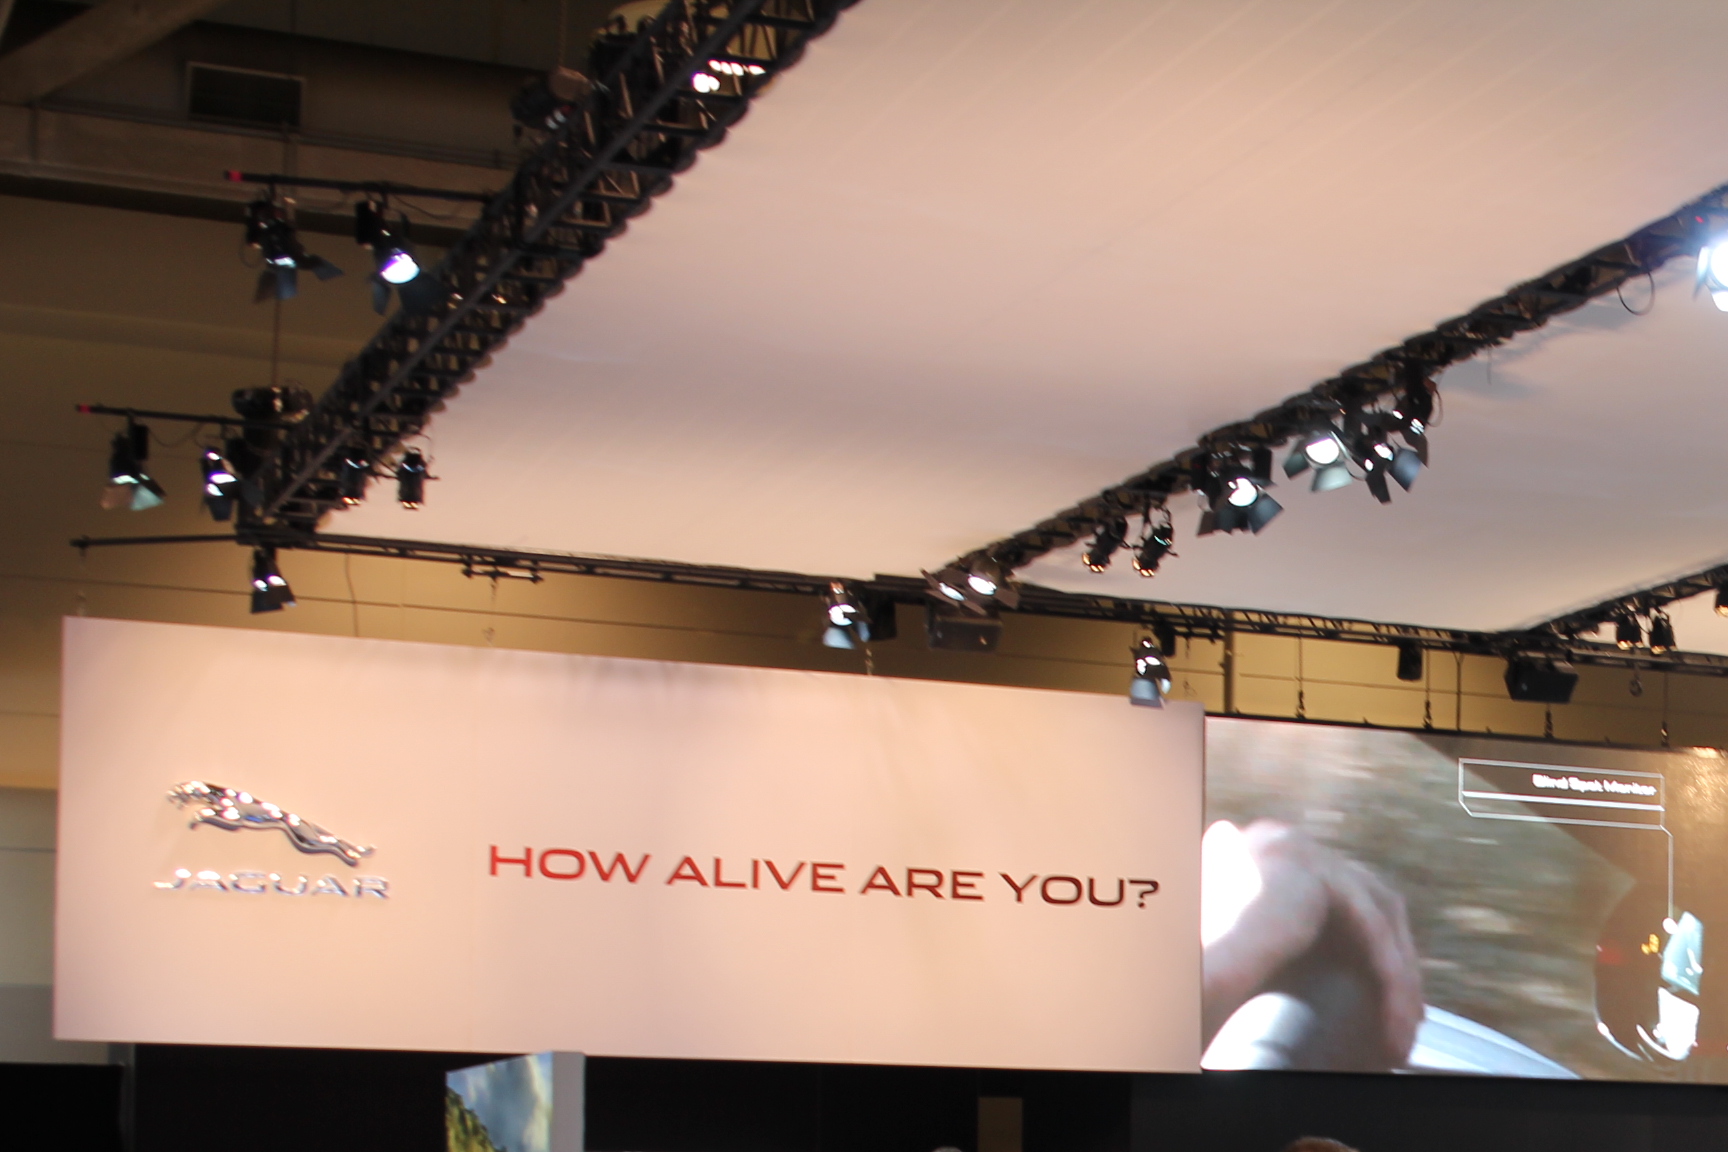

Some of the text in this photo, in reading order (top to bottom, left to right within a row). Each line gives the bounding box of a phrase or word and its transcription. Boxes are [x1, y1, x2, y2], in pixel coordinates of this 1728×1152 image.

[153, 867, 390, 900] JAGUAR
[487, 844, 1160, 909] HOW ALIVE ARE YOU?
